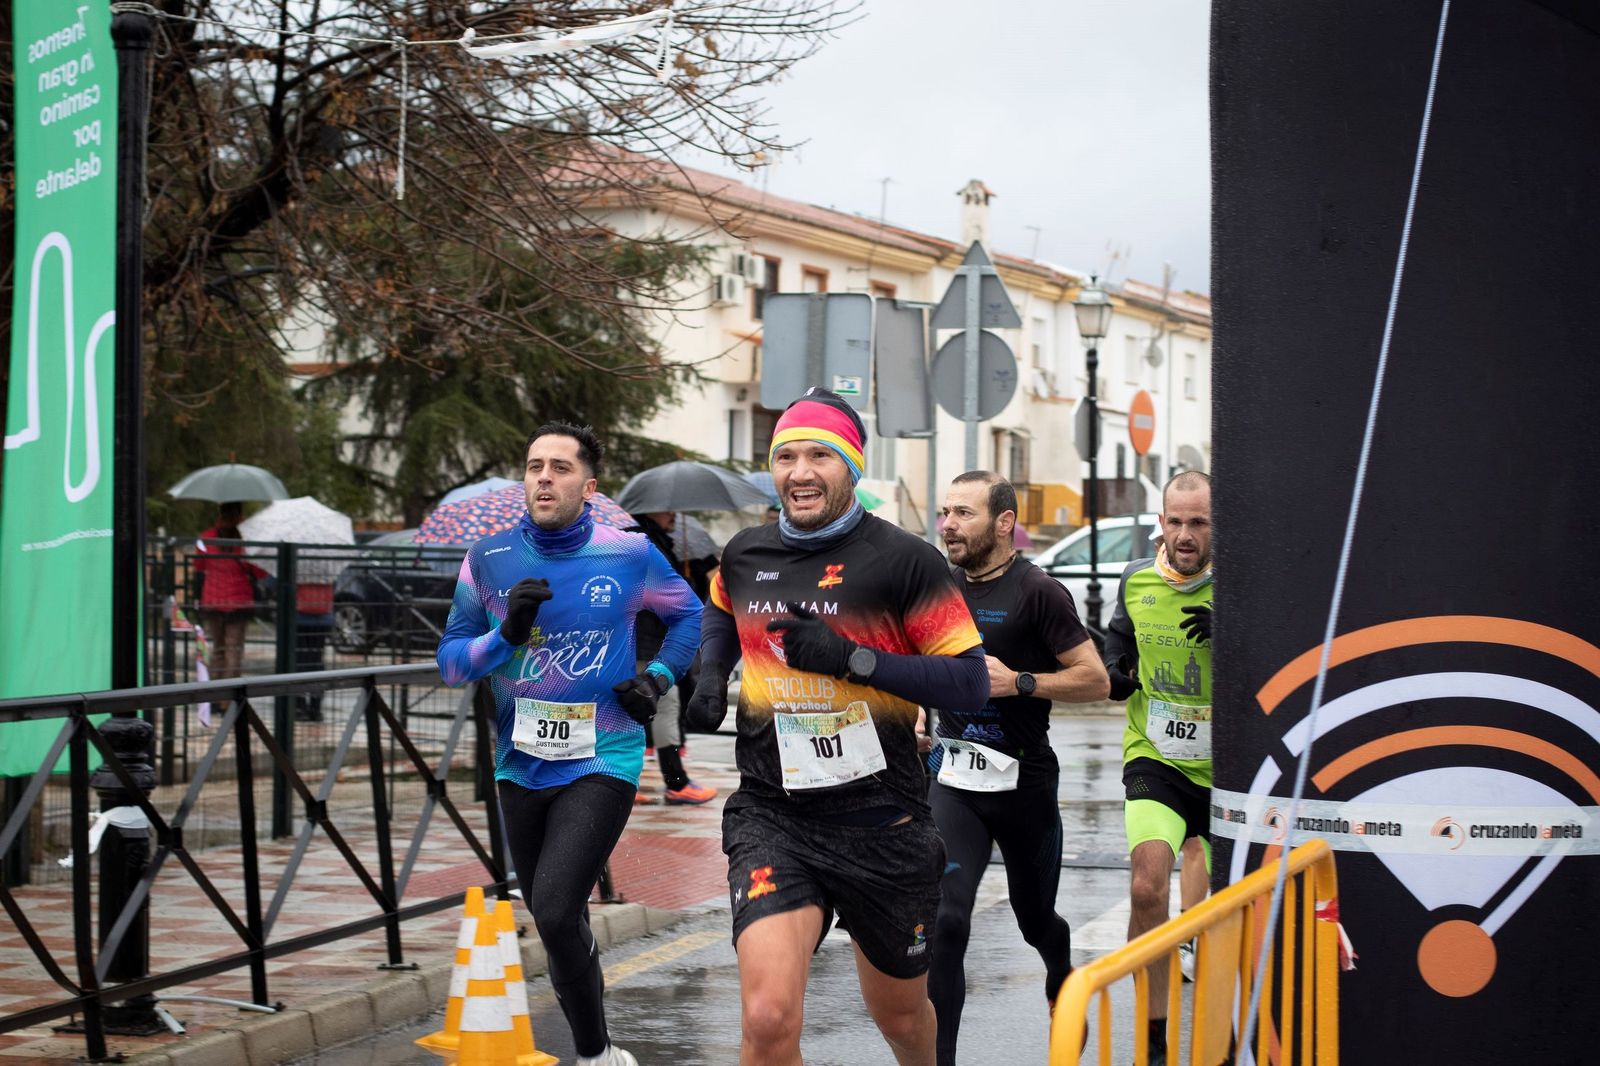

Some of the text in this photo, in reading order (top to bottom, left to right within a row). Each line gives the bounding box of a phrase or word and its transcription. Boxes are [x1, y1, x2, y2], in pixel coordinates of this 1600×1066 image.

[1141, 595, 1156, 607] edp
[1152, 623, 1175, 632] MEDIO
[1139, 633, 1212, 650] DE SEVILLA
[515, 643, 609, 685] LORCA
[765, 676, 836, 700] TRICLUB
[536, 719, 570, 740] 370
[817, 724, 836, 736] 2026
[1165, 719, 1197, 740] 462
[535, 740, 569, 749] GUSTINILLO
[809, 733, 843, 759] 107
[968, 751, 987, 771] 76
